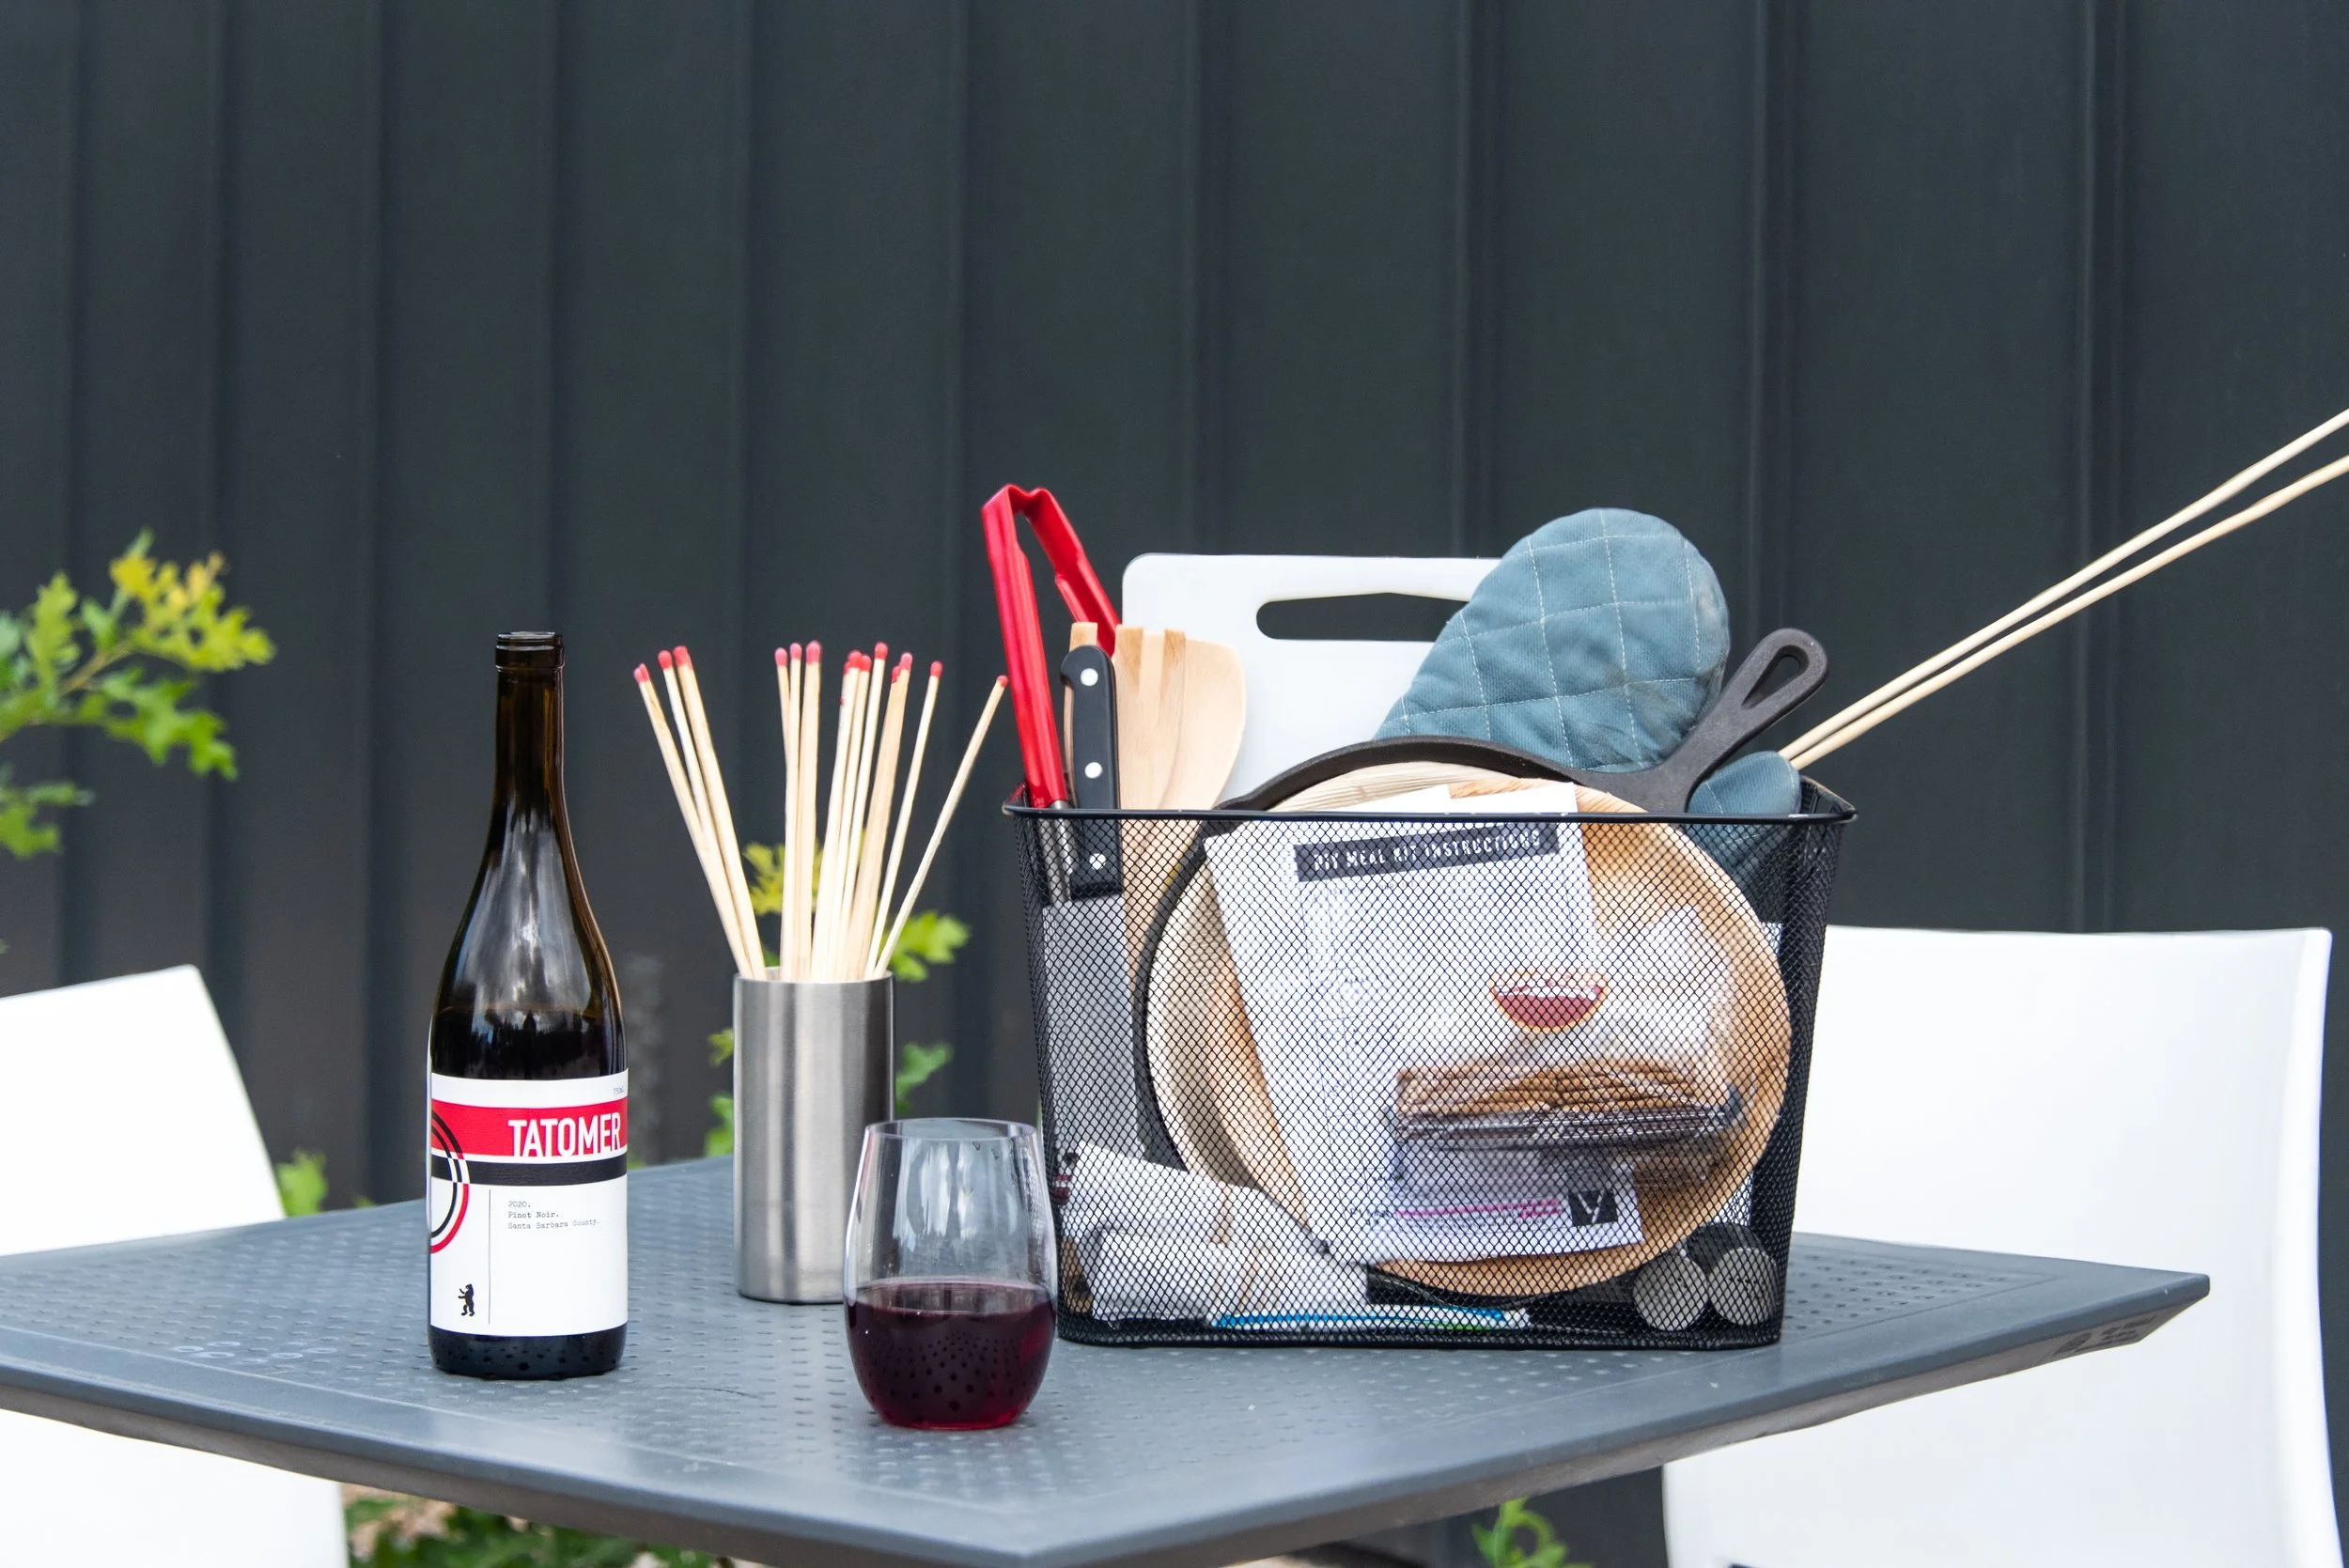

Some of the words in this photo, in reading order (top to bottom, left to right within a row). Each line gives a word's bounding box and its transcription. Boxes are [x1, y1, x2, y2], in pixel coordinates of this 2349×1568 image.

[1314, 852, 1339, 872] DIY
[1346, 848, 1387, 867] MEAL
[1393, 846, 1418, 863] KIT
[1424, 829, 1541, 860] INSTRUCTIONS
[507, 1112, 621, 1157] TATOMER
[507, 1221, 532, 1230] Santa
[536, 1220, 568, 1230] Barbara
